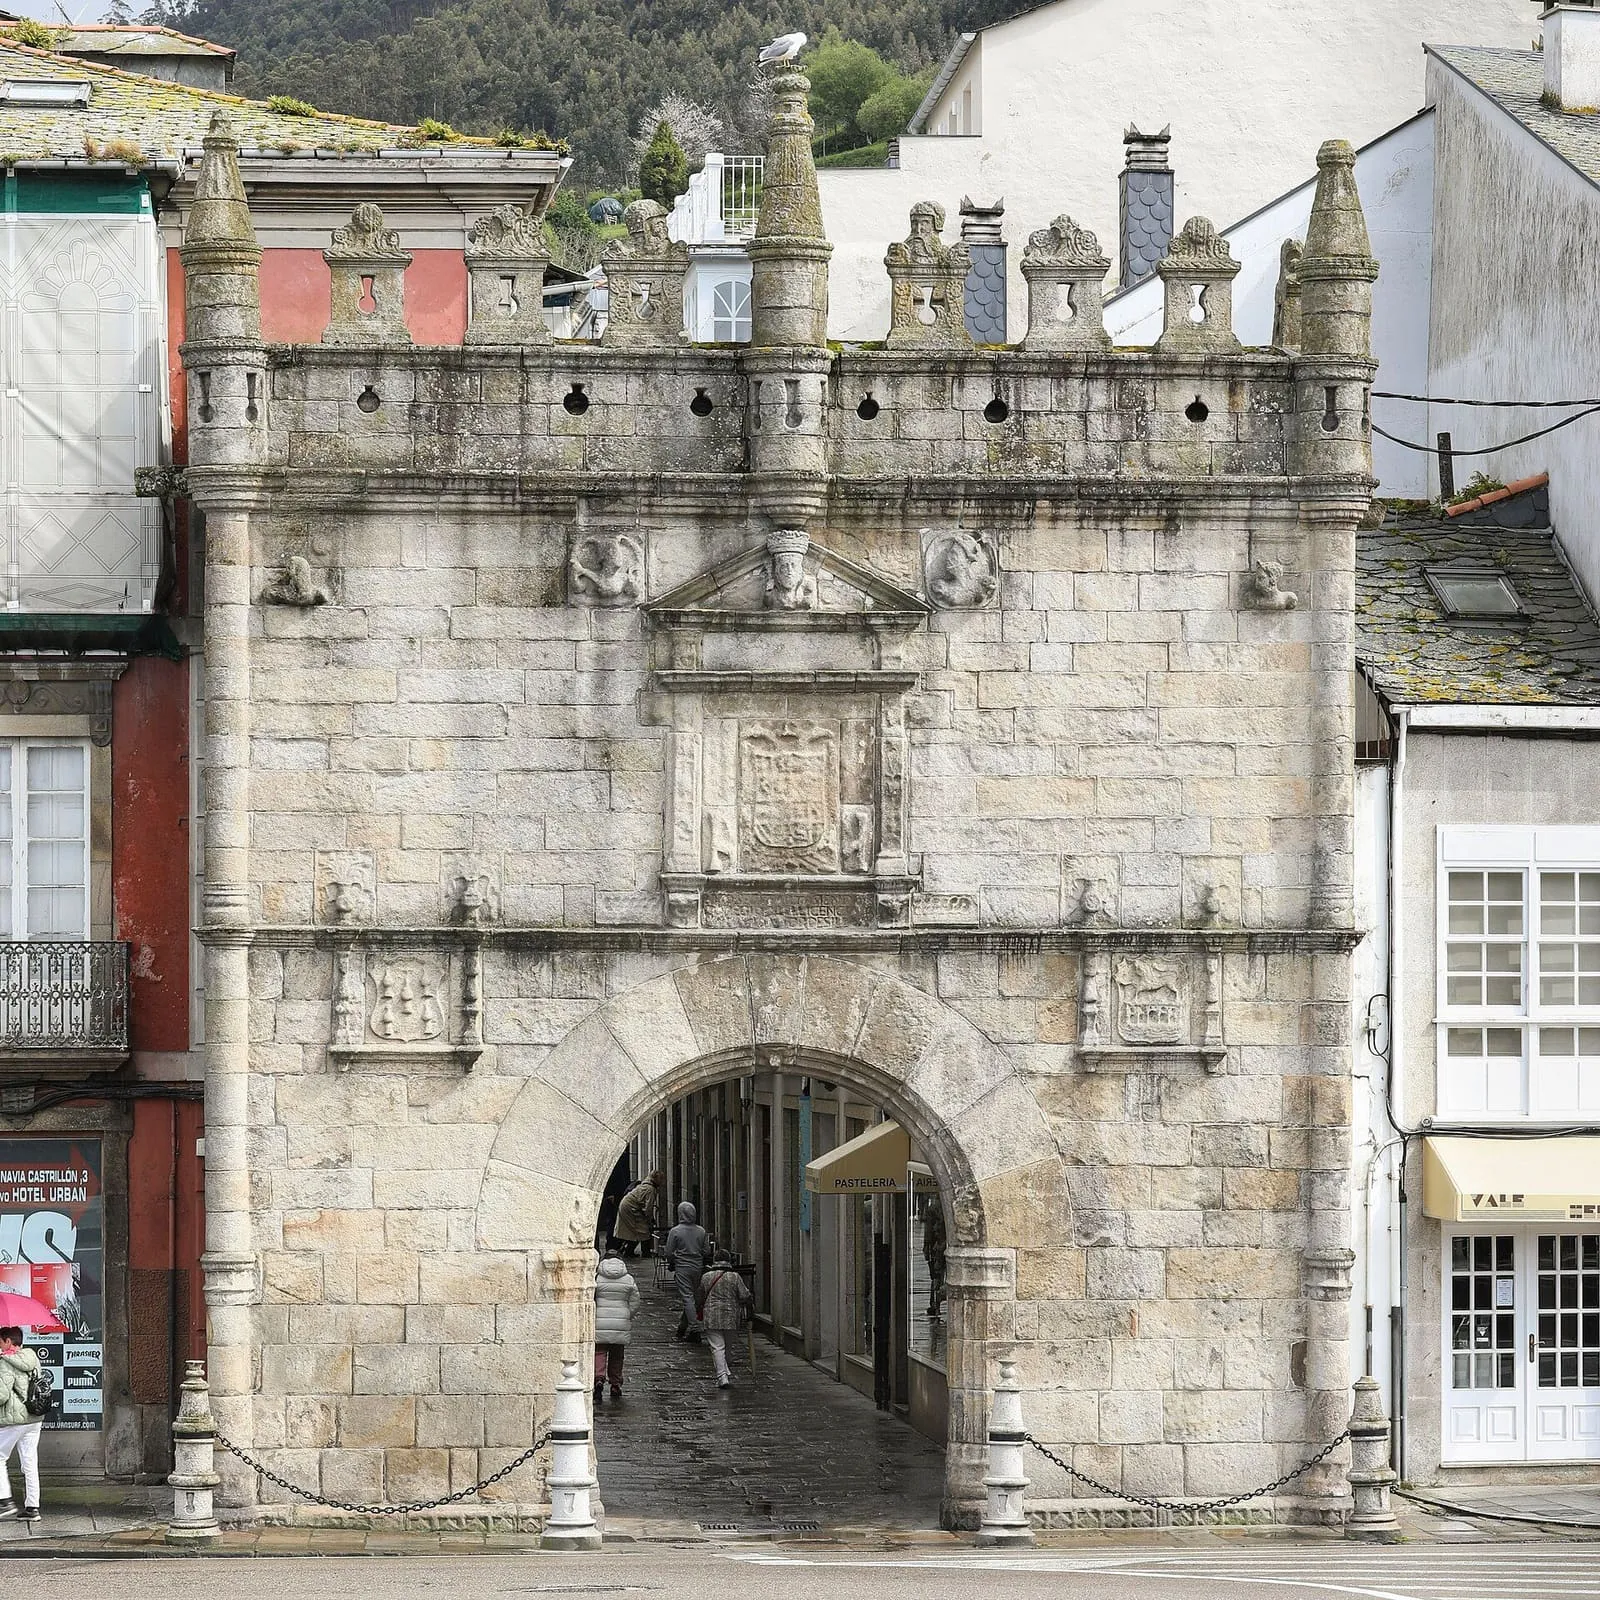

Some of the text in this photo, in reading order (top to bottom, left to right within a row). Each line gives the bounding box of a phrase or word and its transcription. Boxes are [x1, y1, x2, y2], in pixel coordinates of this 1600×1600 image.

[0, 1170, 26, 1183] NAVIA
[28, 1167, 78, 1183] CASTRILLÓN
[834, 1178, 897, 1188] PASTELERIA
[12, 1187, 46, 1202] HOTEL
[49, 1187, 87, 1202] URBAN
[1470, 1194, 1525, 1208] VALE
[66, 1350, 101, 1360] THRASHER
[67, 1377, 93, 1387] PUMA
